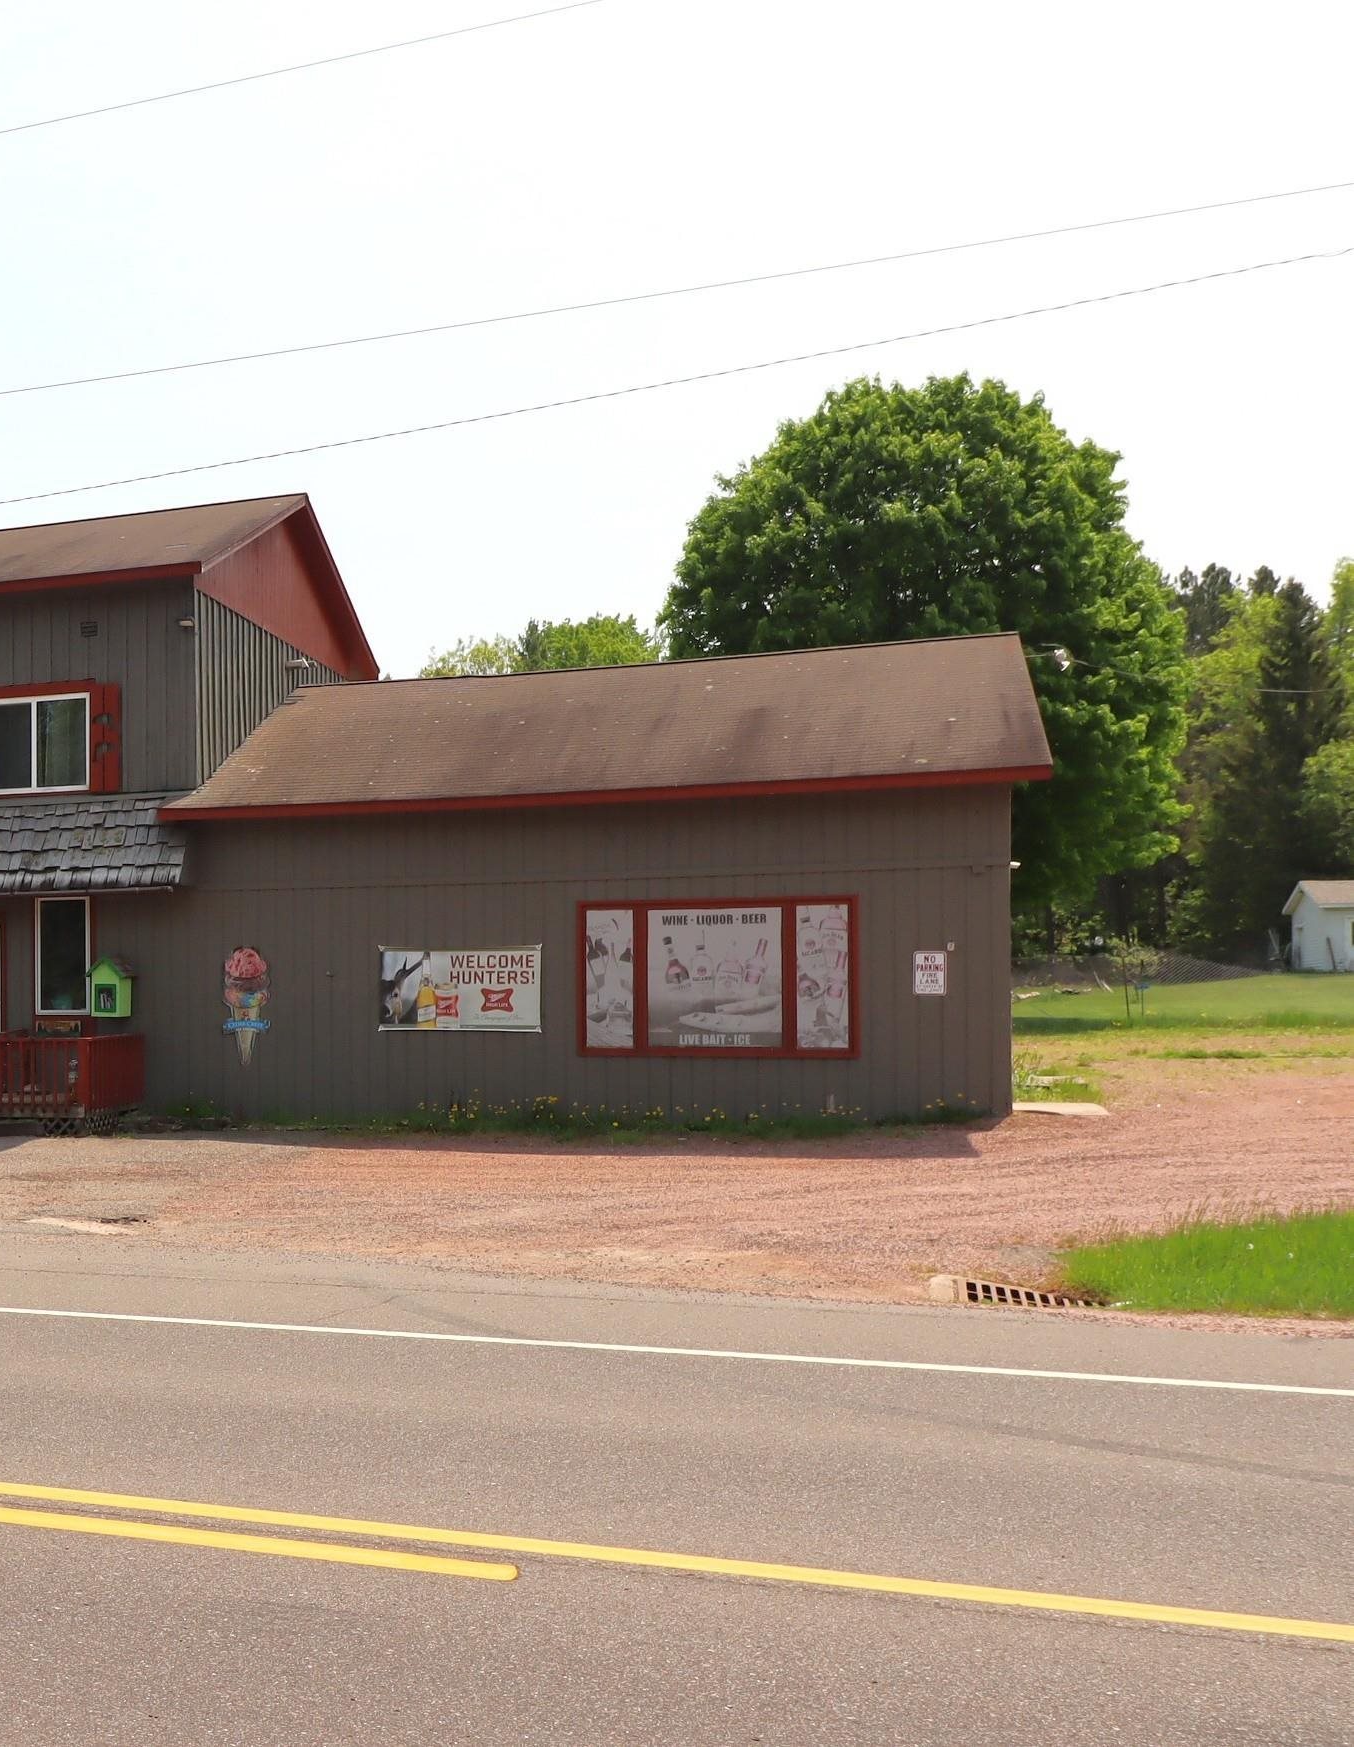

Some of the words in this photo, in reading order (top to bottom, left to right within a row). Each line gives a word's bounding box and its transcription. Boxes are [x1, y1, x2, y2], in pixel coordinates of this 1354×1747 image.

[662, 915, 688, 926] WINE
[696, 914, 733, 926] LIQUOR
[741, 913, 767, 924] BEER
[450, 954, 535, 969] WELCOME
[923, 955, 936, 964] NO
[916, 963, 944, 972] PARKING
[450, 970, 535, 985] HUNTERS!
[678, 1034, 700, 1046] LIVE
[702, 1034, 726, 1046] BAIT
[733, 1034, 751, 1046] ICE
